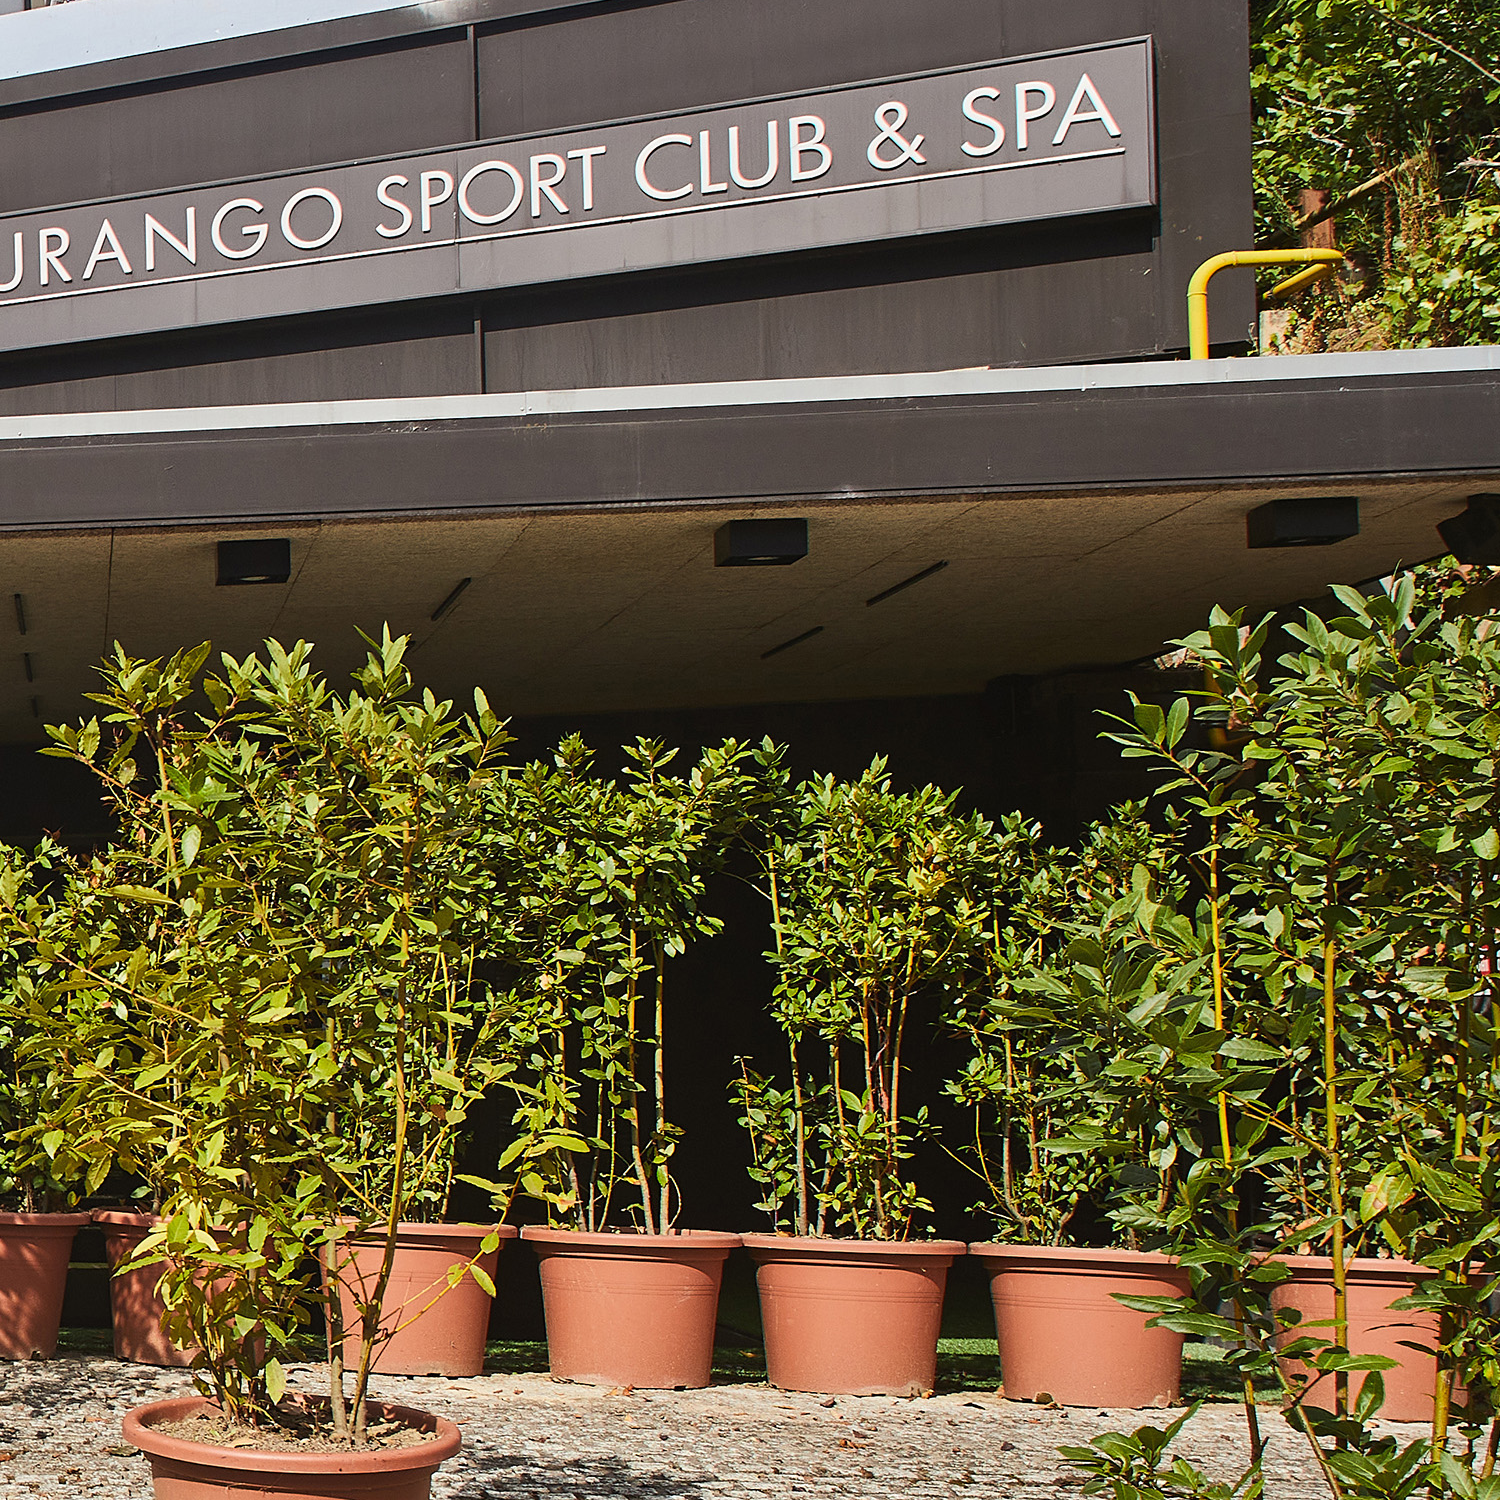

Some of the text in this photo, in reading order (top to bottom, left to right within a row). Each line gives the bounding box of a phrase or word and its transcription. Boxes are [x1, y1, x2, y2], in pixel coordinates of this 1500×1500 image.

[374, 146, 607, 238] SPORT
[634, 115, 833, 200] CLUB
[867, 100, 926, 169] &
[960, 72, 1122, 156] SPA
